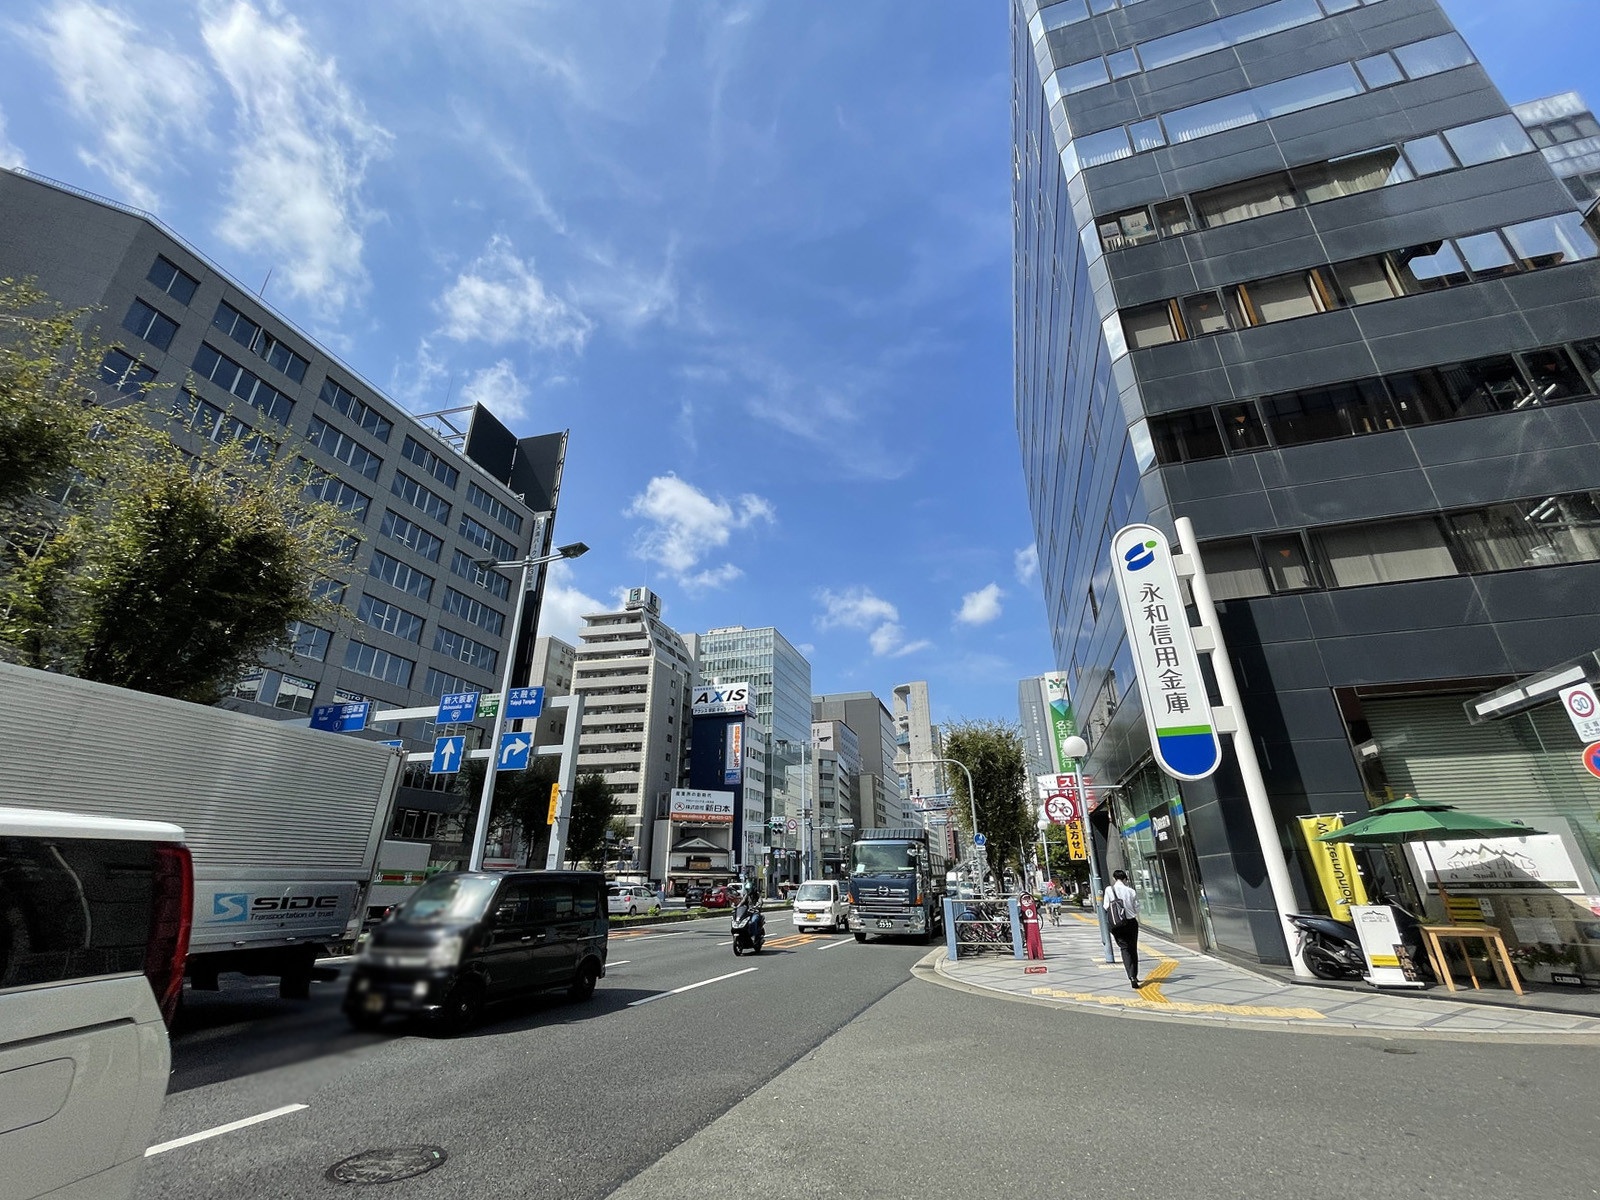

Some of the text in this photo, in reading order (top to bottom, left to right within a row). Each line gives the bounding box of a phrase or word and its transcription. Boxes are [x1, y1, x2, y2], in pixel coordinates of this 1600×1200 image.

[527, 518, 543, 588] 西天満パーク3号館
[1139, 582, 1191, 714] 永和信用金庫
[444, 694, 474, 705] 新大阪駅
[694, 688, 747, 704] AXIS
[1573, 697, 1589, 711] 30
[1068, 821, 1083, 859] 処方せん
[1447, 858, 1538, 872] SEVEN HILLS
[252, 895, 339, 911] SIDE
[250, 913, 307, 921] Transportation
